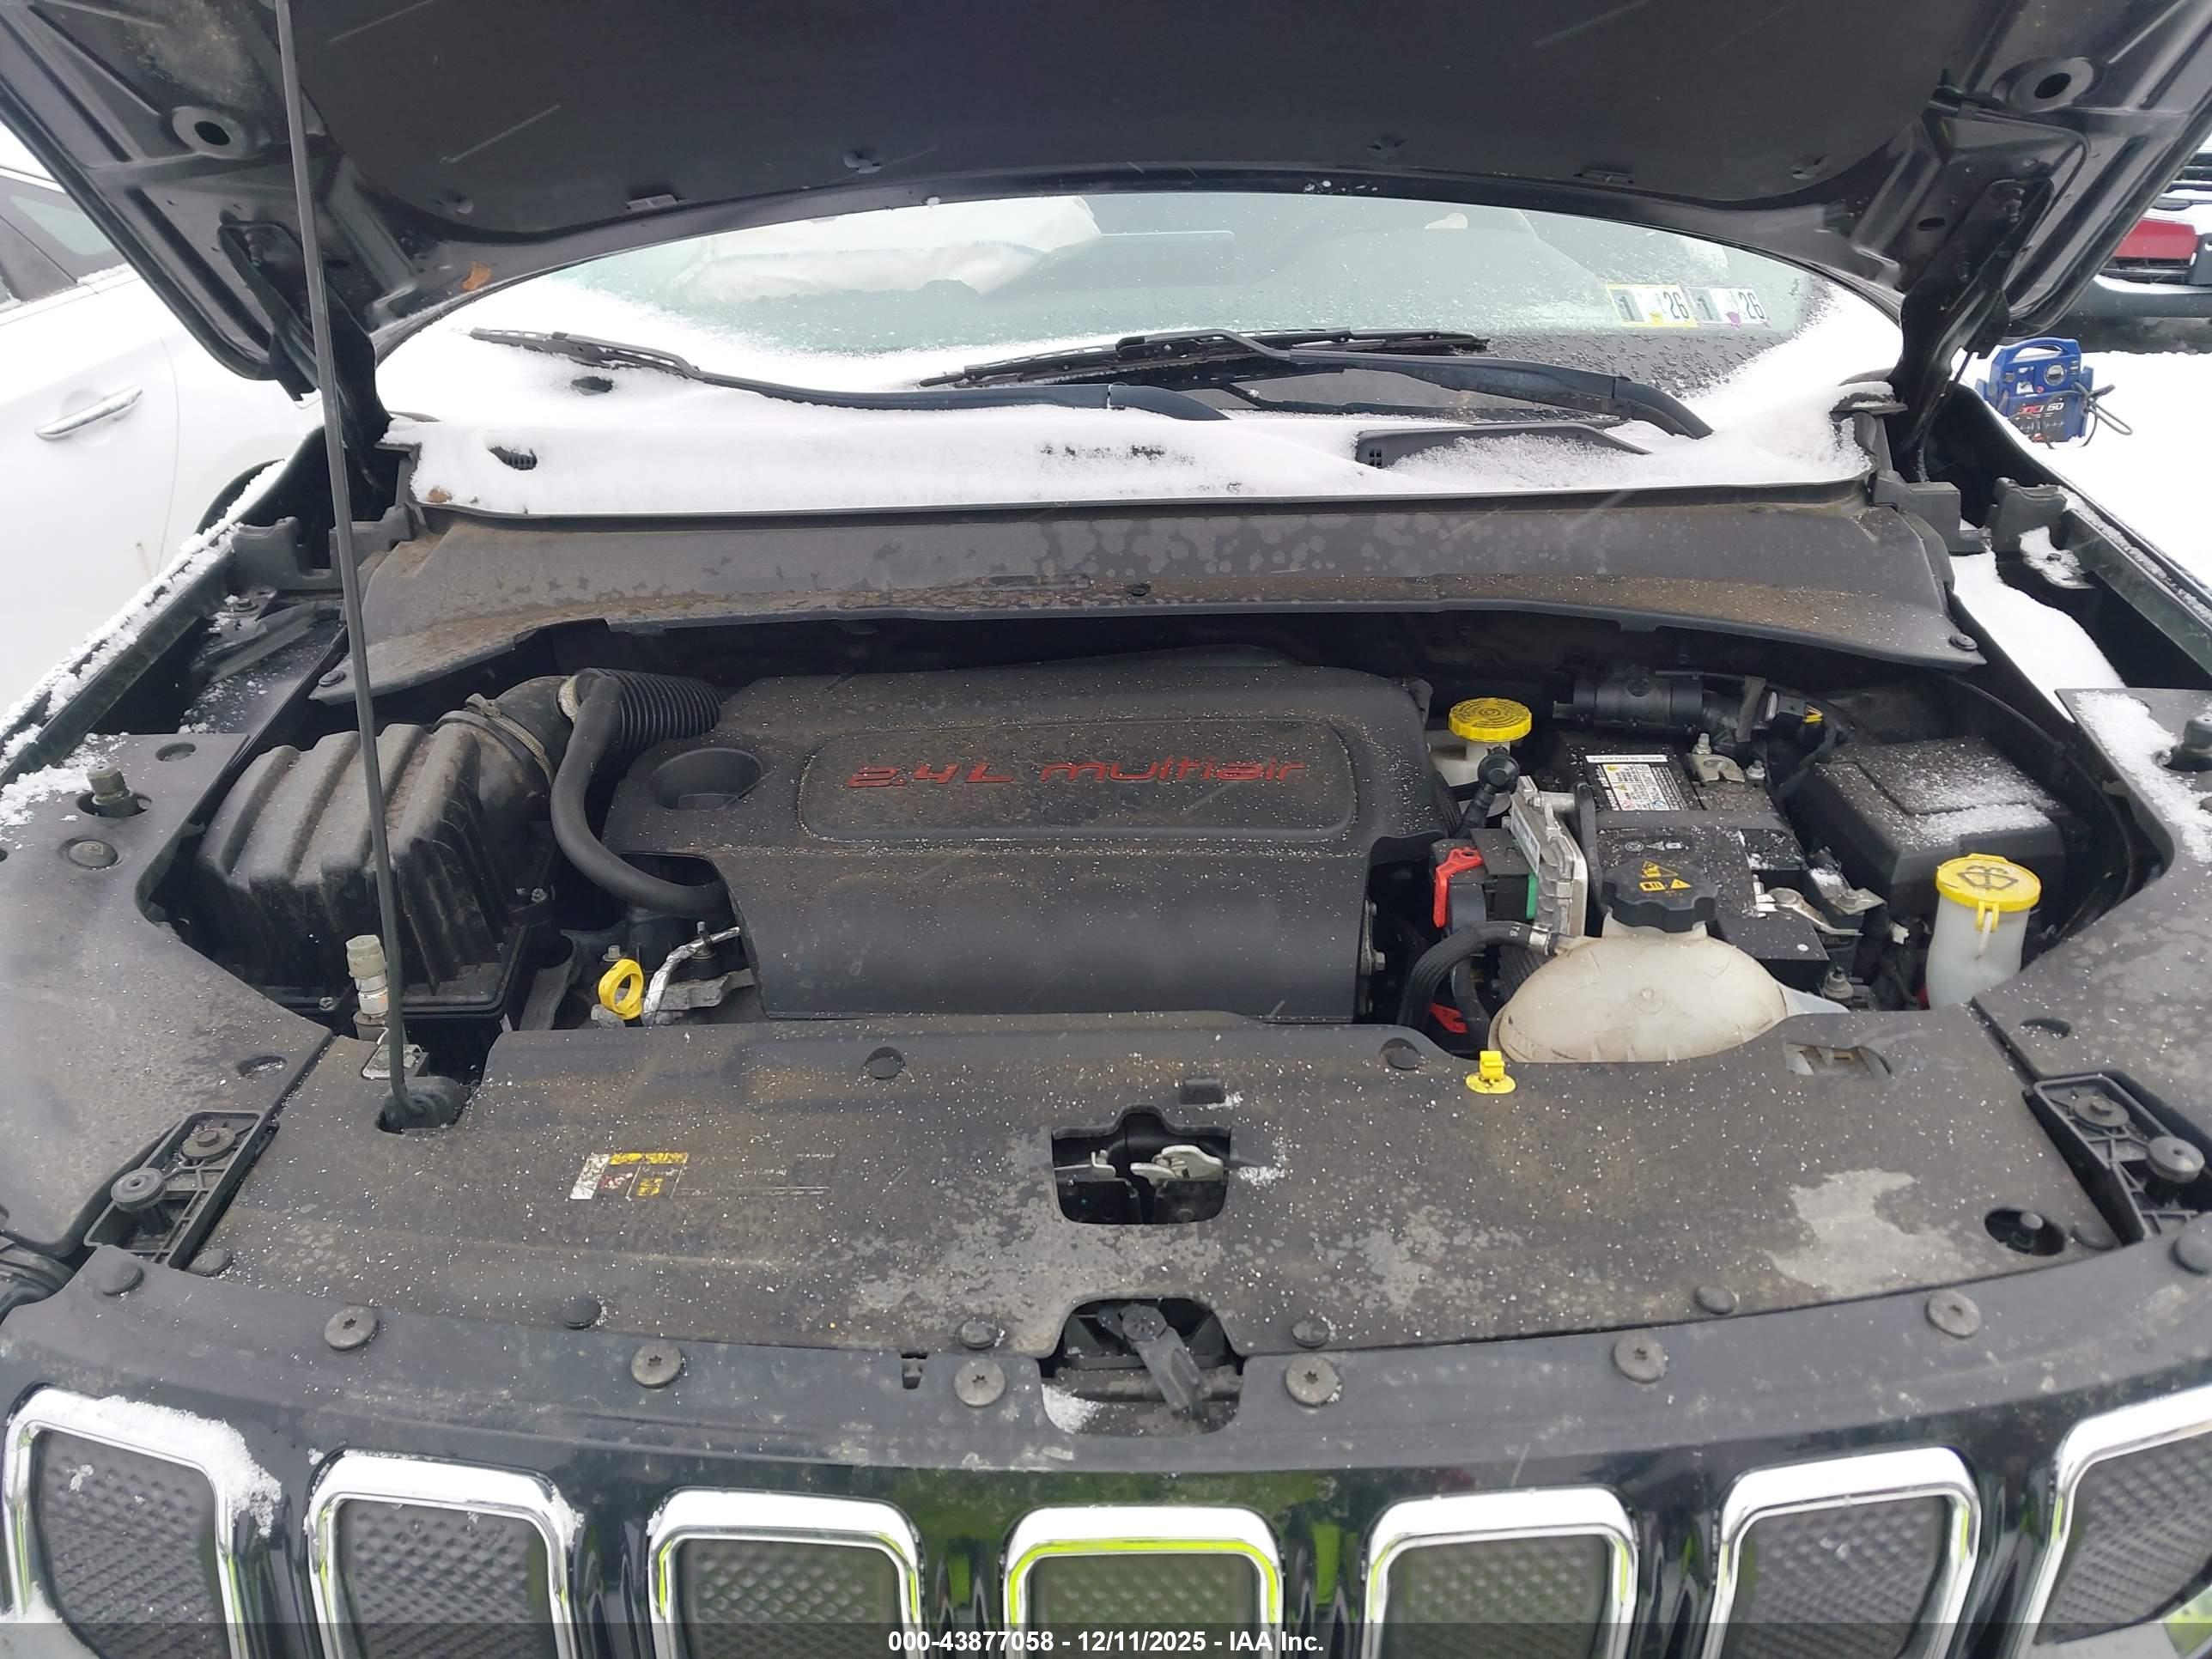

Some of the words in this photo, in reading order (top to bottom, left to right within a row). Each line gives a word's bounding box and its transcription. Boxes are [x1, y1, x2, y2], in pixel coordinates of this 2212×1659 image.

[1662, 291, 1689, 319] 26
[1738, 291, 1765, 319] 26
[1039, 756, 1306, 783] multiair
